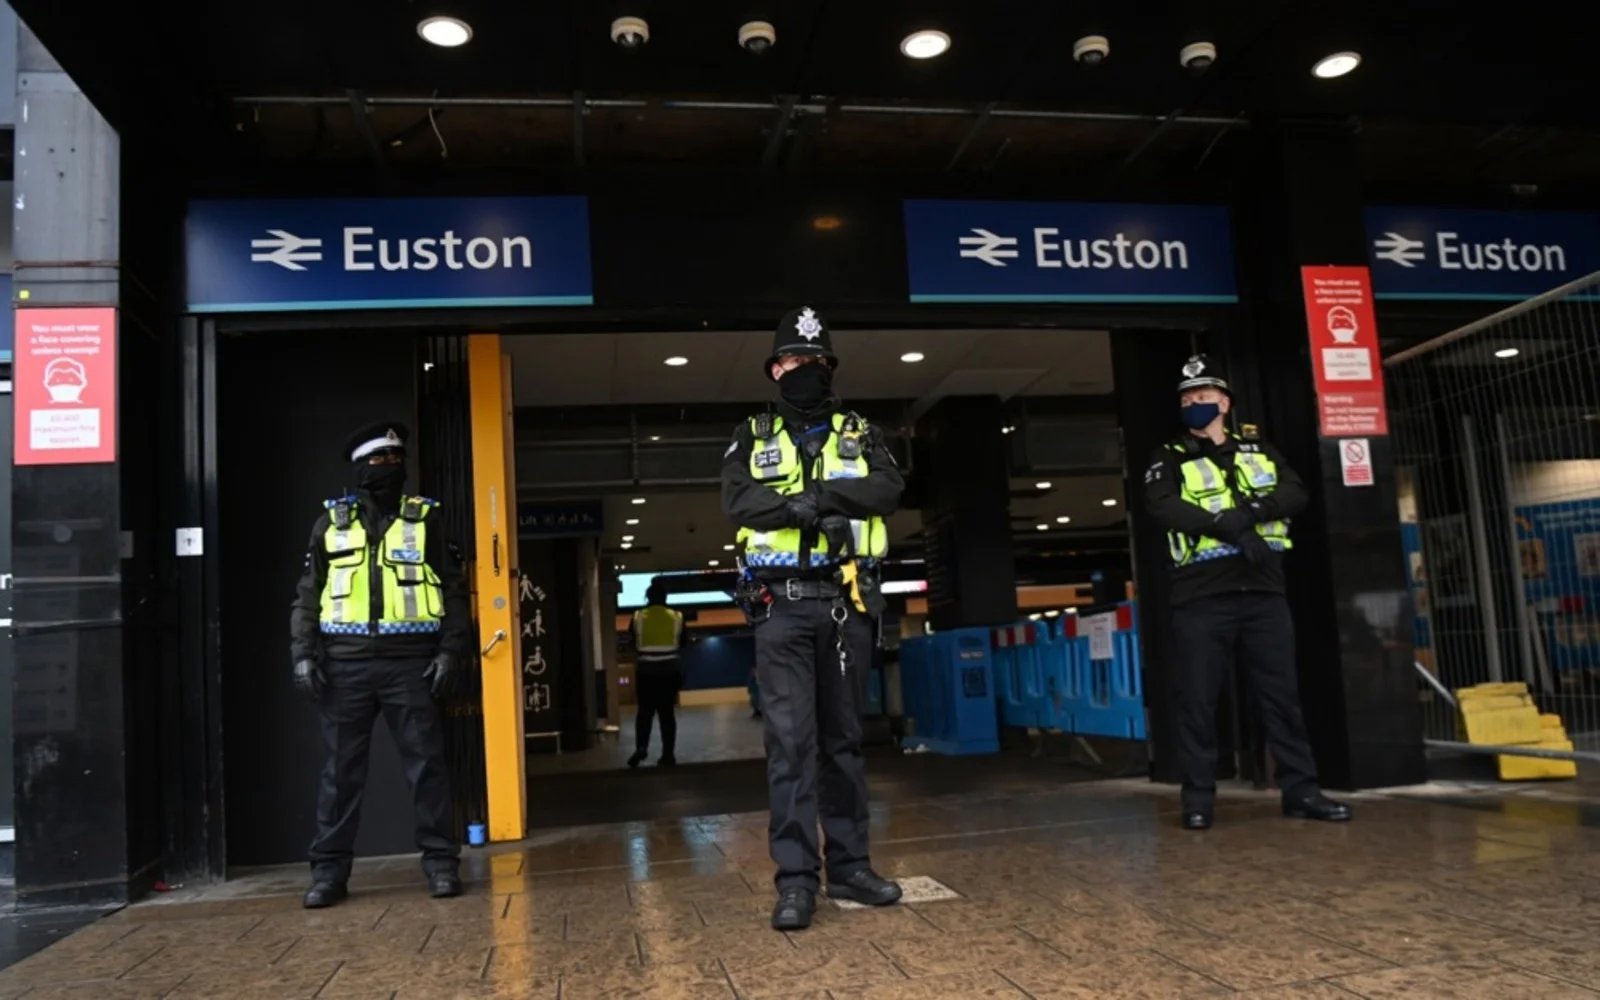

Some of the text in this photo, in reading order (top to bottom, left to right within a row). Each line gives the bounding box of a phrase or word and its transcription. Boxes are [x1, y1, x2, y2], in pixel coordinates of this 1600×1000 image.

[343, 226, 533, 271] Euston
[1034, 227, 1189, 270] Euston
[1436, 231, 1567, 272] Euston
